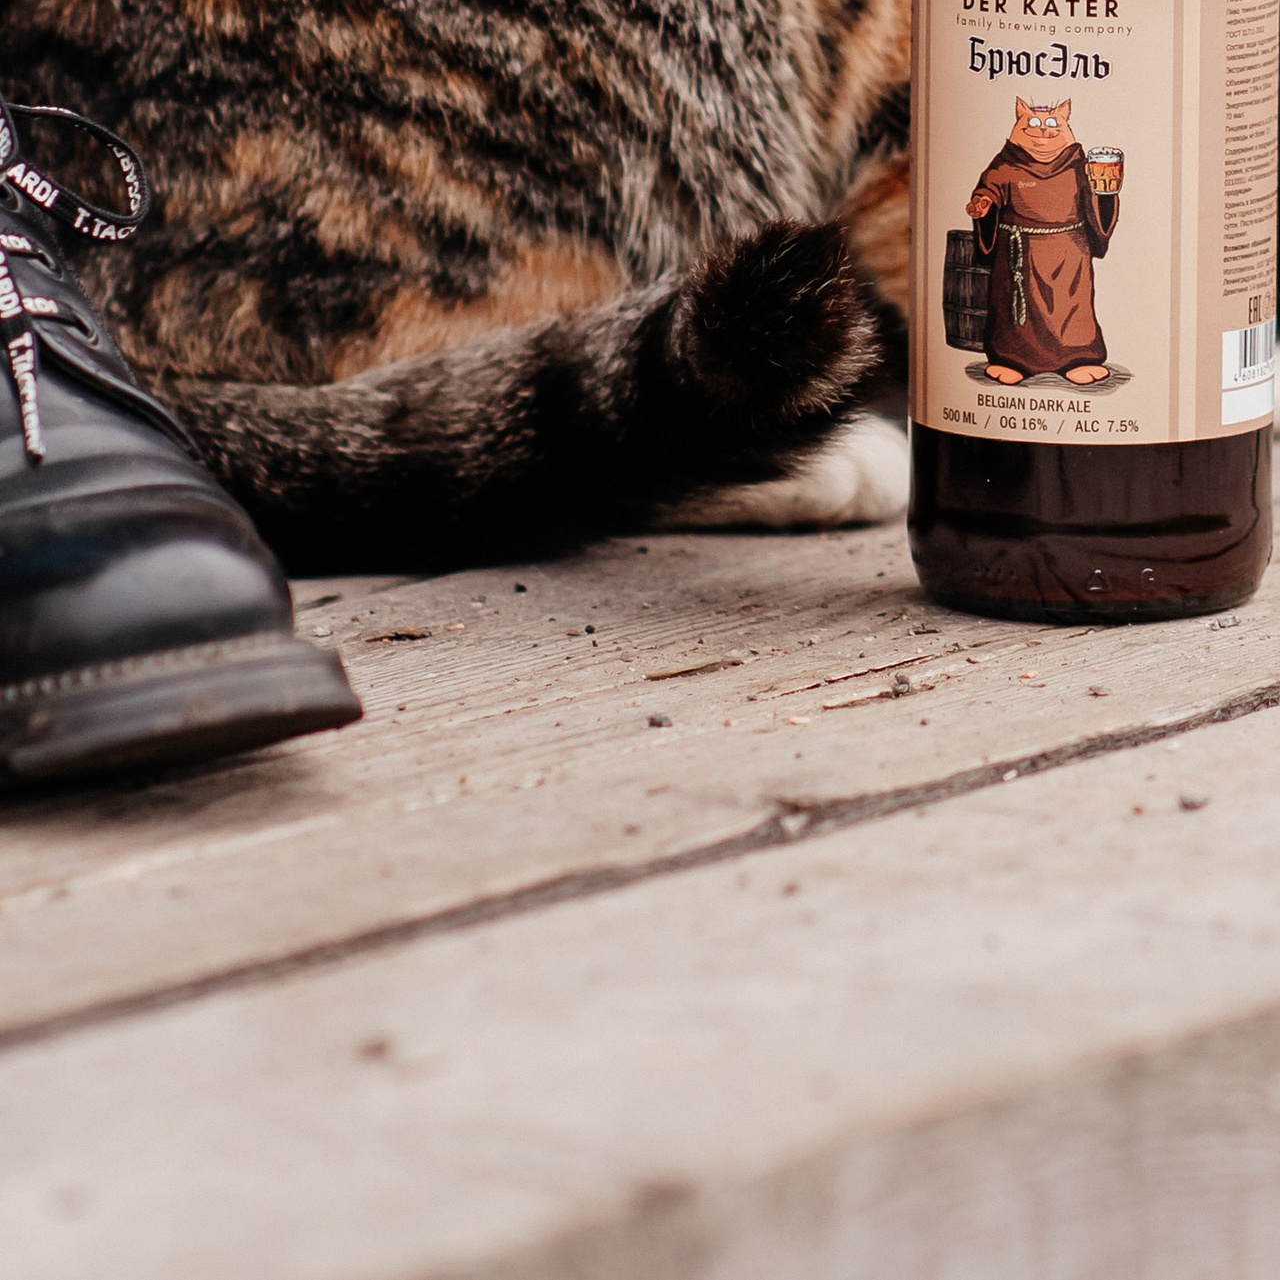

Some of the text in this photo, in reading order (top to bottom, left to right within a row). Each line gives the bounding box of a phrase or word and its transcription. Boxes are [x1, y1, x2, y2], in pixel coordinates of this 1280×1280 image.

[956, 14, 1133, 37] family brewing company
[968, 36, 1111, 81] БрюсЭль
[977, 393, 1091, 413] BELGIAN DARK ALE
[943, 407, 960, 422] 500
[962, 411, 977, 425] ML
[999, 415, 1017, 429] OG
[1021, 417, 1048, 431] 16%
[1075, 420, 1100, 433] ALC
[1107, 419, 1139, 433] 7.5%
